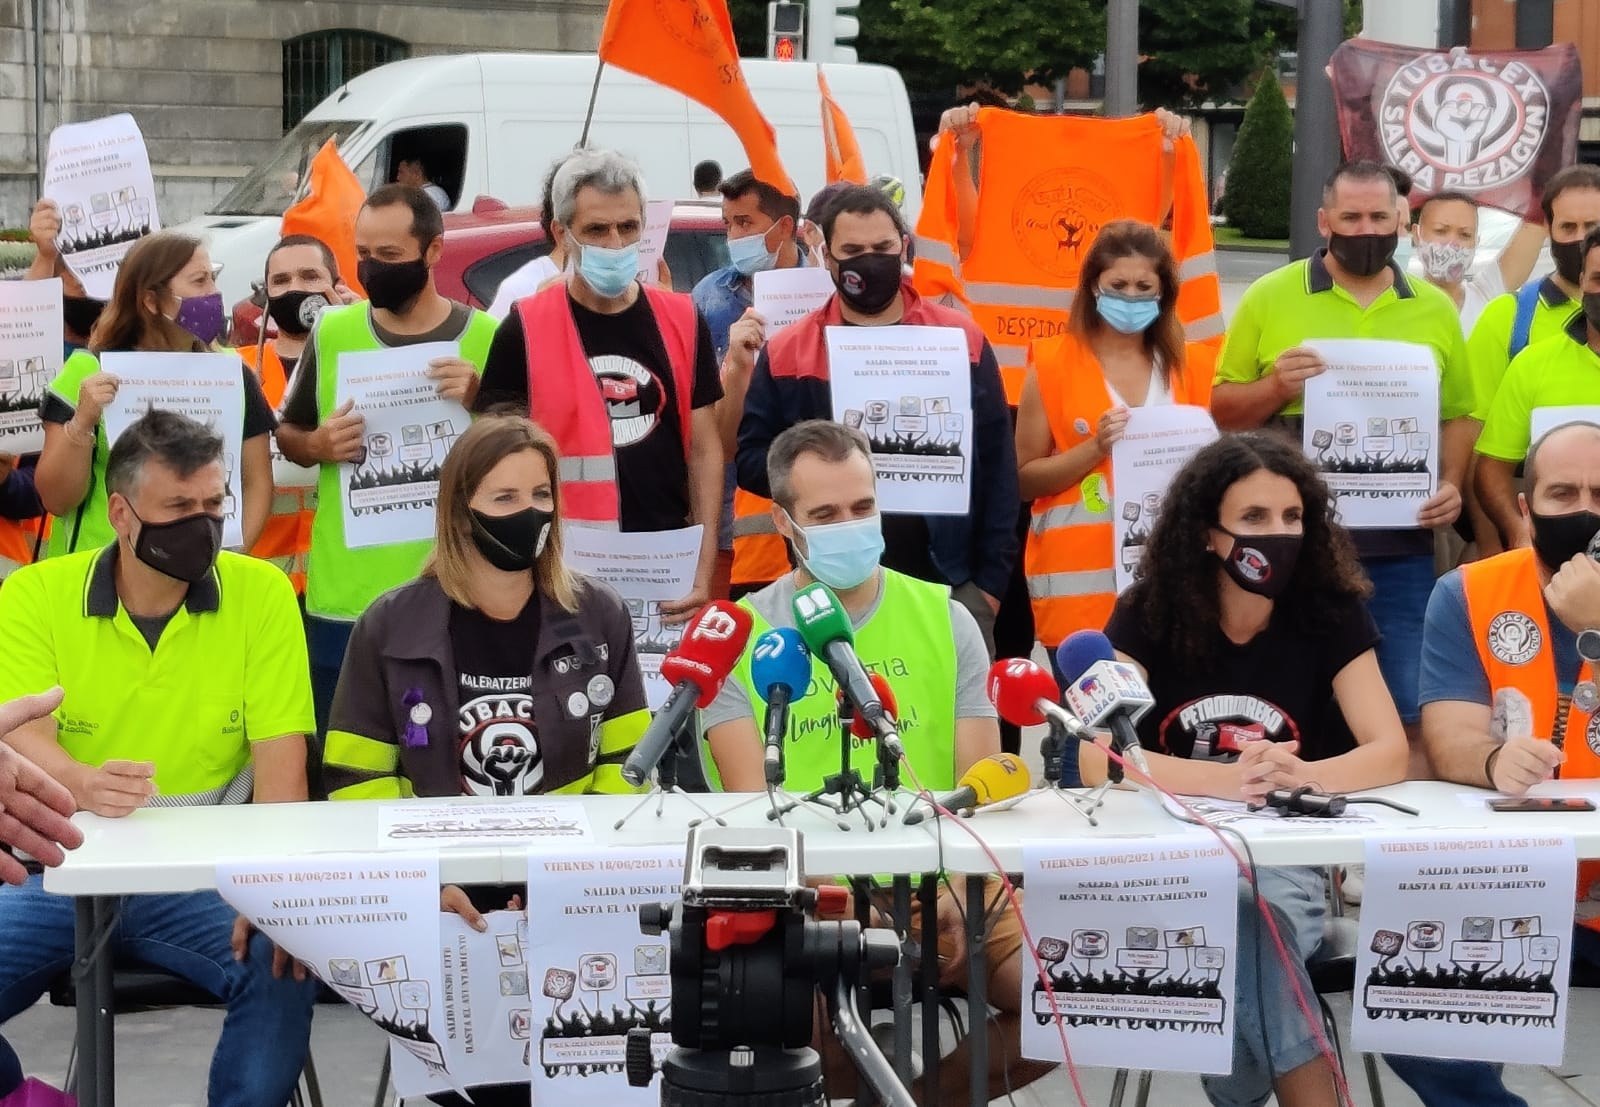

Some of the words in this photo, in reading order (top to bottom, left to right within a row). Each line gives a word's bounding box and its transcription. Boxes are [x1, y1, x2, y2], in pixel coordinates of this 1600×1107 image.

[1391, 55, 1541, 99] TUBACEX
[1443, 105, 1545, 188] DEZAGUN
[1083, 692, 1116, 727] BILBAO
[1381, 843, 1429, 853] VIERNES
[1433, 840, 1494, 851] 18/06/2021
[1498, 840, 1506, 848] A
[1509, 839, 1529, 848] LAS
[1531, 838, 1563, 847] 10:00
[544, 861, 595, 872] VIERNES
[599, 860, 662, 871] 18/06/2021
[667, 859, 677, 868] A
[1039, 859, 1089, 870] VIERNES
[1093, 853, 1155, 866] 18/06/2021
[1159, 851, 1166, 861] A
[1170, 849, 1190, 860] LAS
[1193, 847, 1225, 857] 10:00
[232, 873, 284, 885] VIERNES
[287, 871, 352, 882] 18/06/2021
[358, 871, 366, 880] A
[369, 870, 392, 879] LAS
[394, 869, 427, 879] 10:00
[1418, 866, 1459, 876] SALIDA
[1462, 866, 1499, 875] DESDE
[1502, 864, 1529, 874] EITB
[1078, 881, 1120, 889] SALIDA
[1123, 878, 1159, 888] DESDE
[1163, 876, 1190, 886] EITB
[1399, 882, 1436, 891] HASTA
[1439, 882, 1453, 890] EL
[1456, 881, 1546, 890] AYUNTAMIENTO
[583, 887, 626, 897] SALIDA
[630, 886, 666, 896] DESDE
[1059, 893, 1097, 901] HASTA
[1100, 893, 1114, 901] EL
[1117, 891, 1208, 902] AYUNTAMIENTO
[272, 897, 314, 910] SALIDA
[319, 896, 357, 907] DESDE
[565, 905, 603, 915] HASTA
[607, 904, 621, 913] EL
[257, 917, 293, 927] HASTA
[297, 916, 309, 926] EL
[314, 912, 407, 925] AYUNTAMIENTO
[446, 1004, 456, 1040] SALIDA
